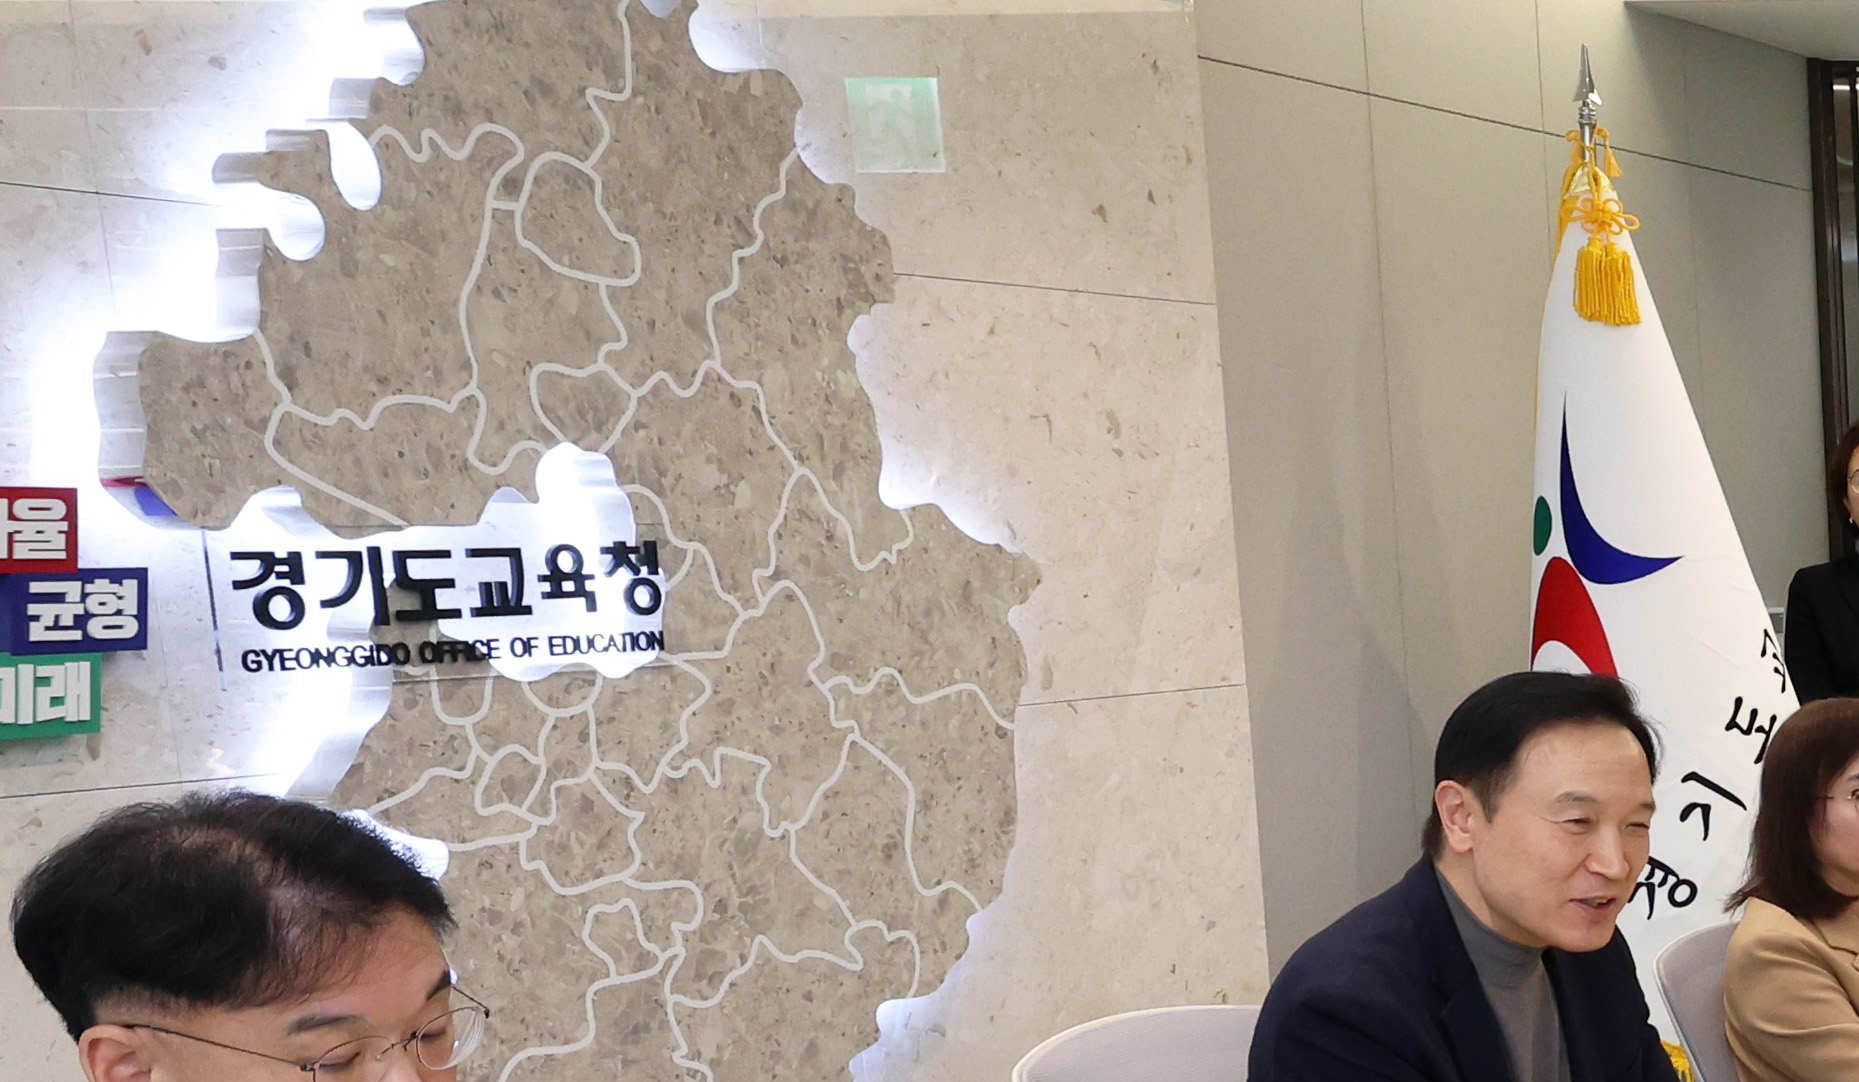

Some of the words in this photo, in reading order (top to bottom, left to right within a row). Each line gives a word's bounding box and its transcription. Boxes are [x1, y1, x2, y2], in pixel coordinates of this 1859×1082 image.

[0, 498, 69, 560] 율
[27, 578, 139, 641] 균형
[230, 541, 661, 631] 경기도교육청
[241, 644, 411, 673] GYEONGGIDO
[418, 640, 501, 665] OFFICE
[510, 637, 540, 658] OF
[548, 630, 666, 657] EDUCATION
